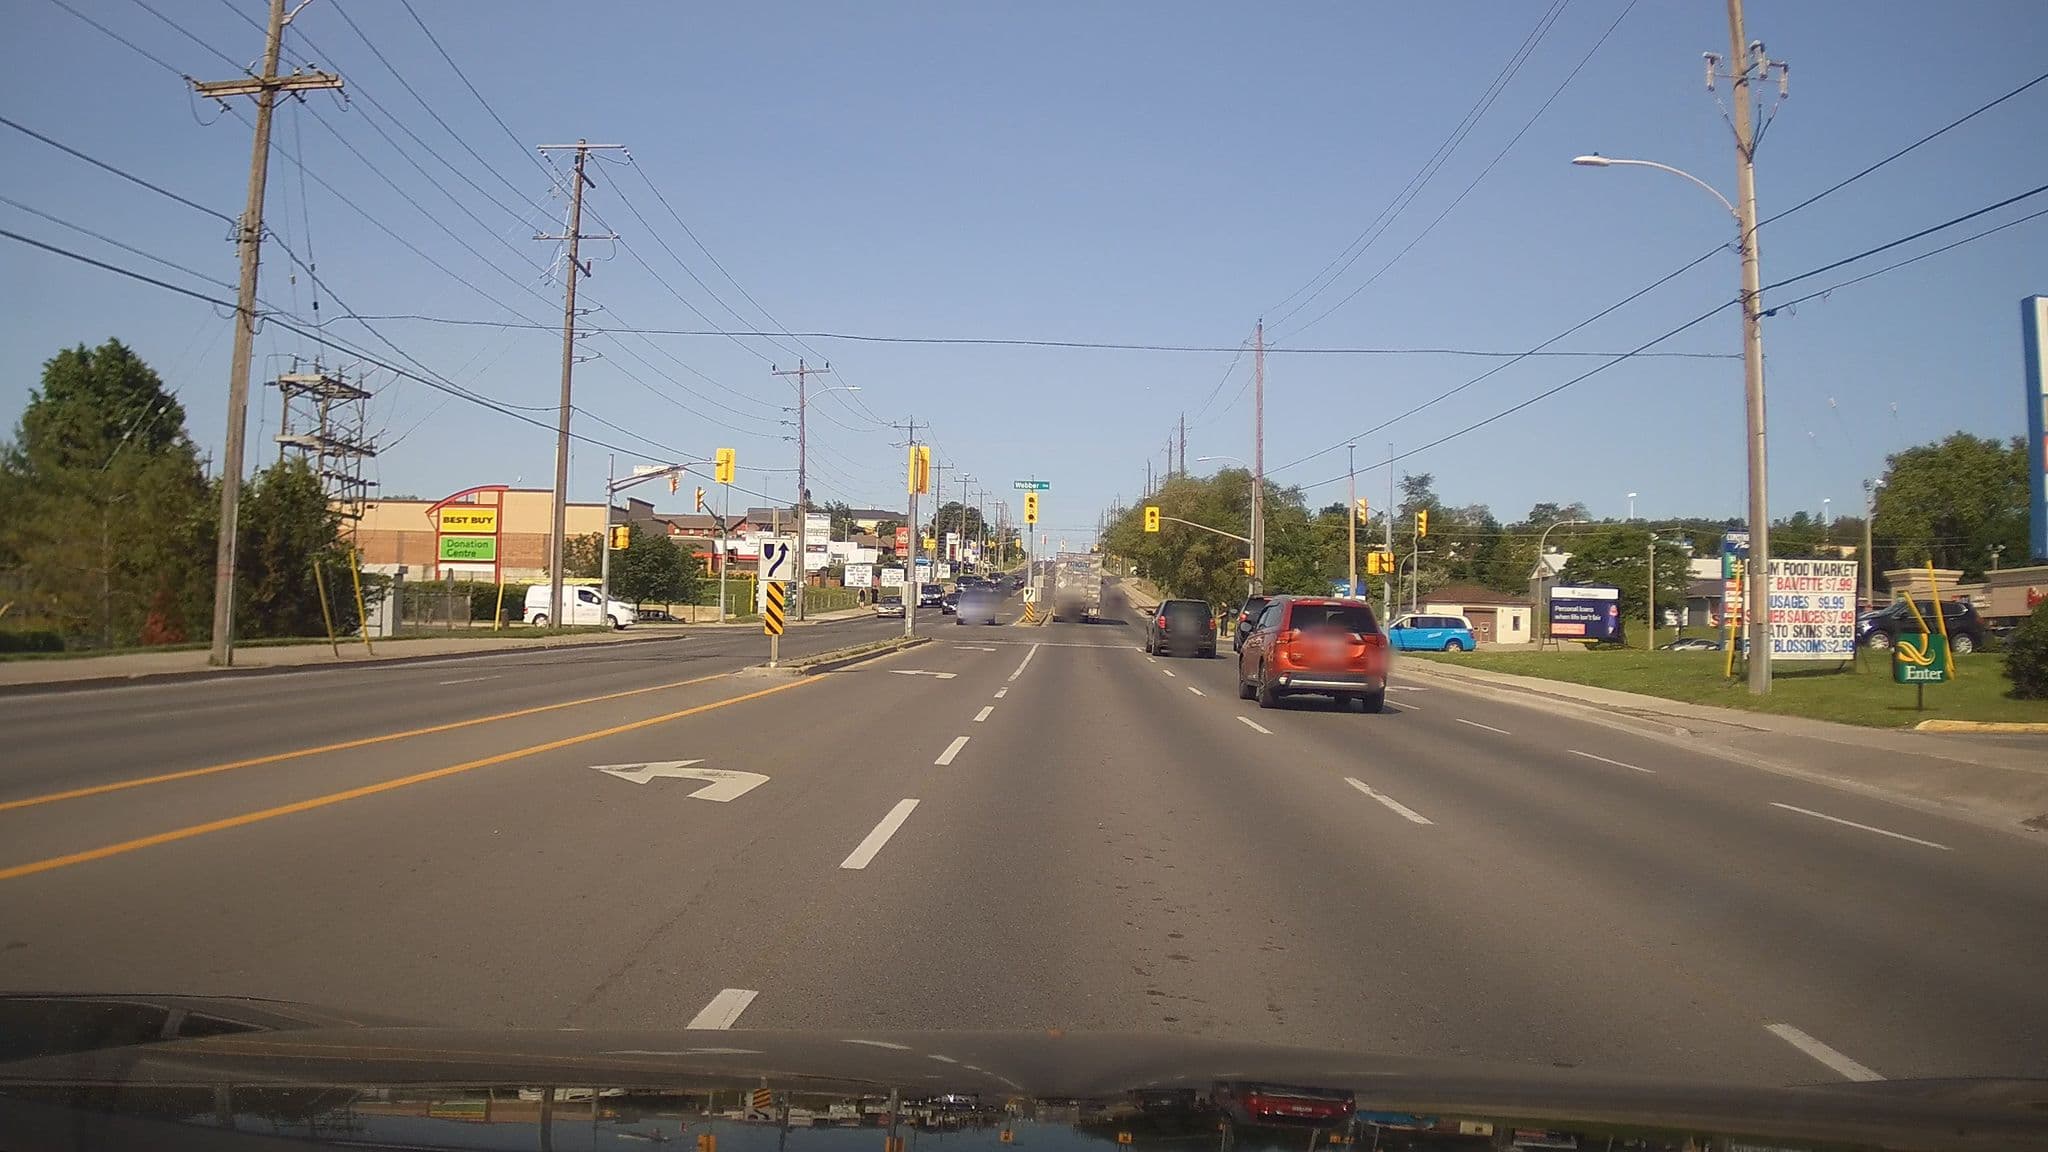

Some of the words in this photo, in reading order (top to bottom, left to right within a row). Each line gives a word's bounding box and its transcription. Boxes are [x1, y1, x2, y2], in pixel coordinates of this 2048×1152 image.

[443, 516, 468, 524] BEST
[471, 516, 493, 524] BUY
[447, 539, 488, 548] Donation
[446, 549, 477, 557] Centre
[1783, 562, 1809, 576] FOOD
[1813, 562, 1857, 577] MARKET
[1776, 577, 1824, 591] BAVETTE
[1826, 578, 1852, 591] $7.99
[1770, 595, 1810, 609] USAGES
[1818, 596, 1845, 609] $9.99
[1787, 610, 1825, 624] SAUCES
[1826, 610, 1854, 624] $7.99
[1793, 625, 1823, 638] SKINS
[1826, 625, 1853, 638] $8.99
[1775, 639, 1827, 652] BLOSSOMS
[1827, 640, 1856, 652] $2.99
[1905, 665, 1944, 680] Enter
